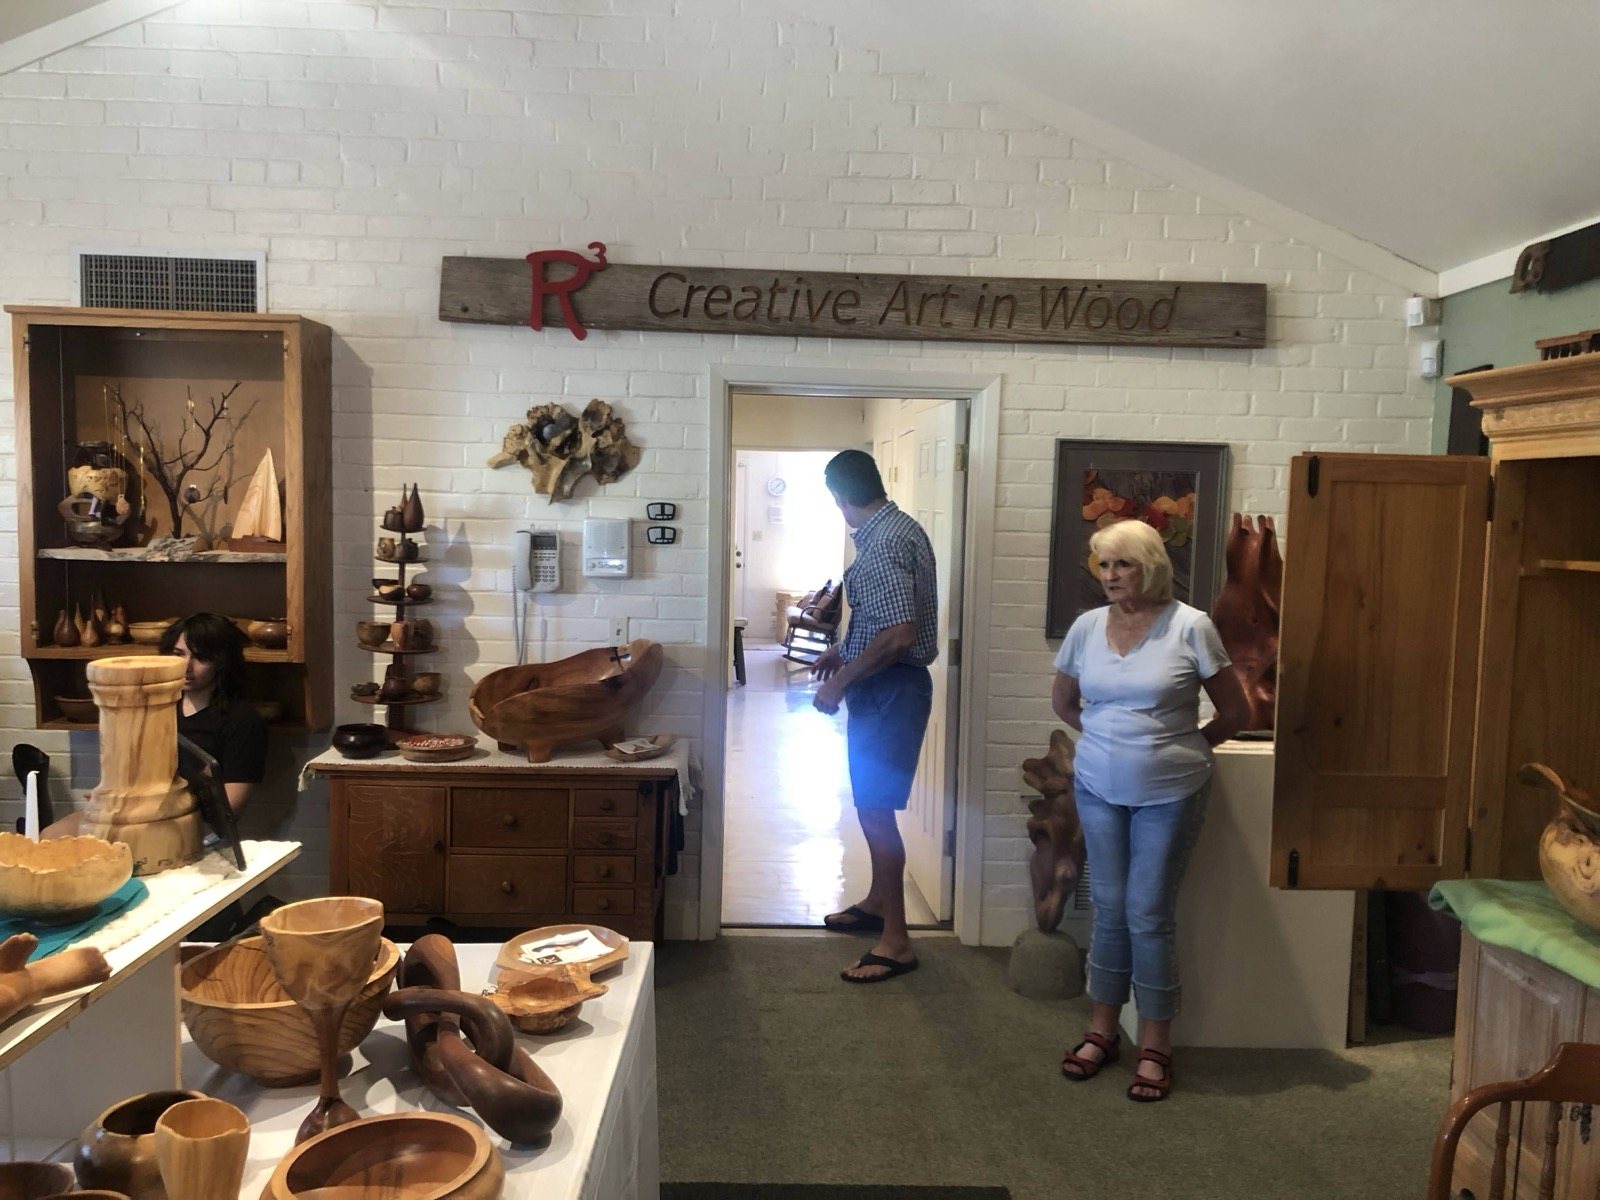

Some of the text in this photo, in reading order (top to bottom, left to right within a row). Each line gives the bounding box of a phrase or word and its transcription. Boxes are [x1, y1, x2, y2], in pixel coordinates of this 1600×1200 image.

[649, 272, 860, 326] Creative
[878, 280, 960, 328] Art
[973, 283, 1019, 331] in
[1040, 285, 1180, 332] Wood
